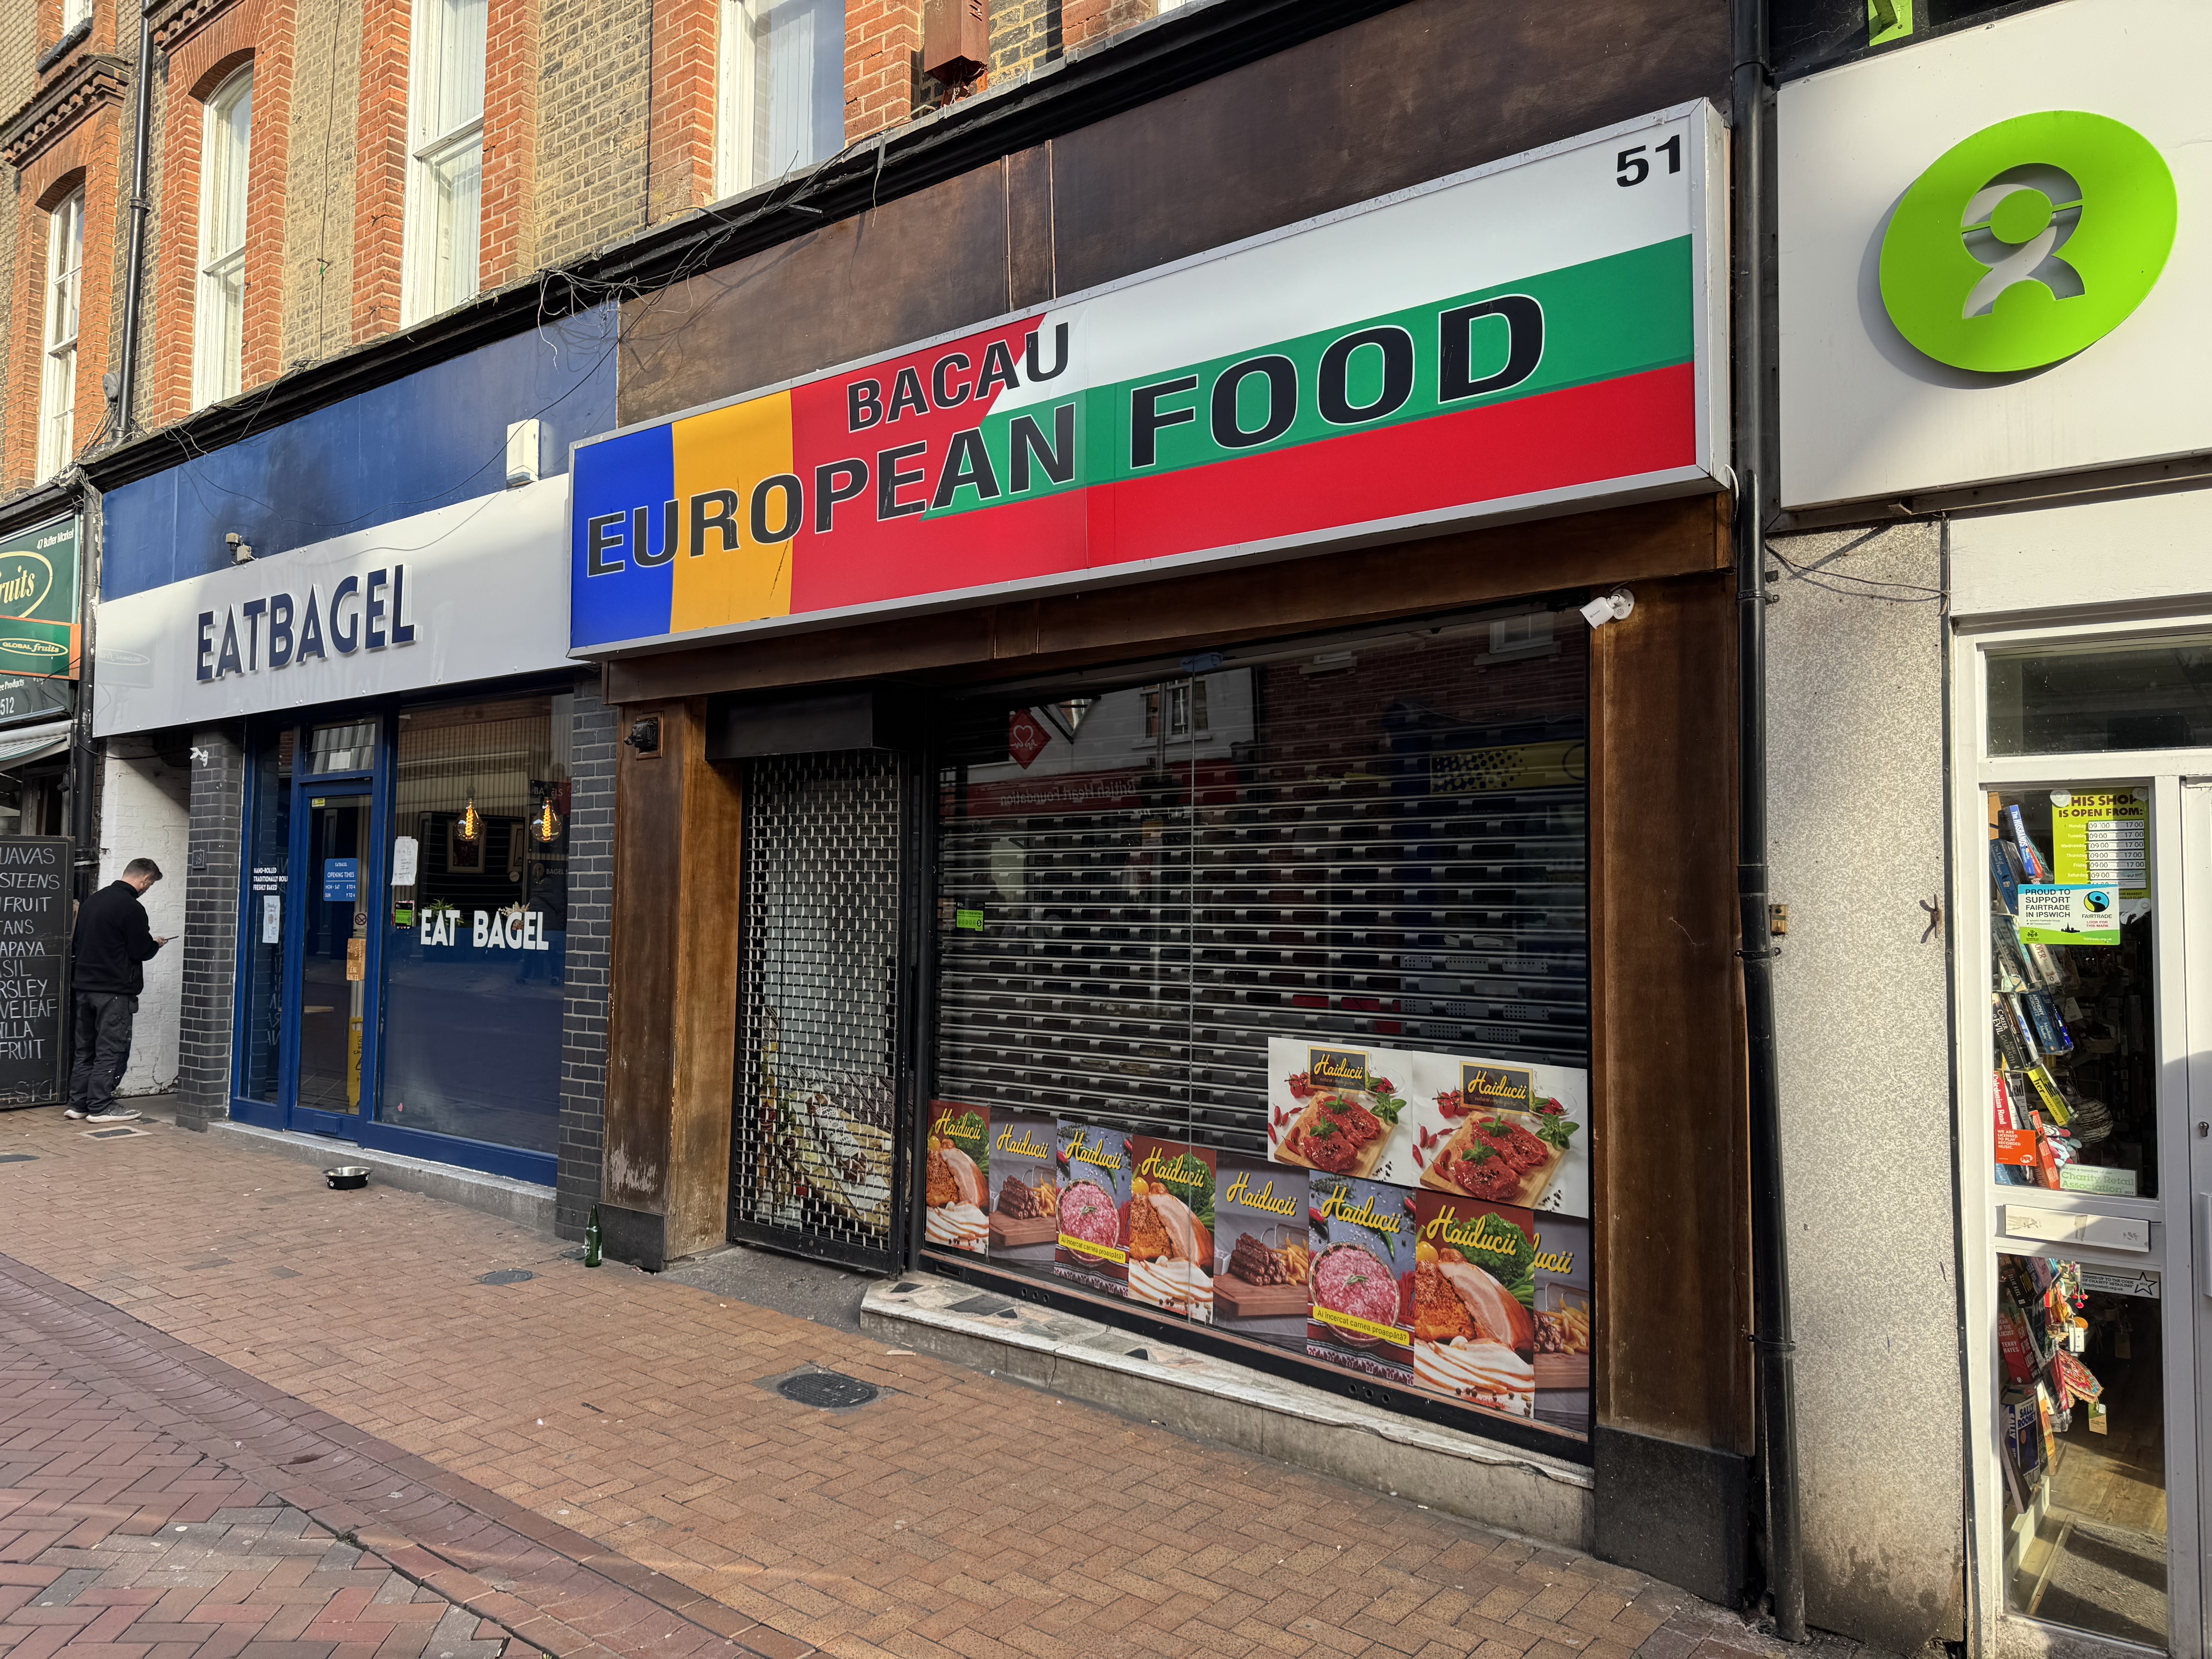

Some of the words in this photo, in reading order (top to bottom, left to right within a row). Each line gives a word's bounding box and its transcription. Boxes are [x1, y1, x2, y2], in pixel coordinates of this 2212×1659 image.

[1616, 135, 1681, 187] 51
[848, 322, 1069, 433] BACAU
[587, 402, 1077, 577] EUROPEAN
[1130, 293, 1545, 469] FOOD
[37, 539, 43, 549] 47
[44, 536, 57, 548] Butter
[58, 528, 74, 543] Market
[0, 565, 35, 603] ruits
[197, 564, 416, 681] EATBAGEL
[31, 643, 59, 653] fruits
[5, 679, 24, 689] Products
[2059, 809, 2069, 817] IS
[2071, 809, 2102, 817] OPEN
[2106, 807, 2143, 816] FROM:
[2066, 796, 2095, 807] HIS
[2013, 819, 2028, 848] HUSBANDS
[4, 896, 52, 912] FRUIT
[421, 909, 460, 946] EAT
[473, 909, 549, 950] BAGEL
[2028, 995, 2040, 1017] HOROWITZ
[2032, 994, 2045, 1016] ANTHONY
[1993, 1019, 2004, 1035] EVIL
[1997, 1009, 2008, 1030] CAREER
[2001, 1035, 2016, 1064] GALBRAITH
[1314, 1053, 1363, 1080] Haiducii
[1468, 1070, 1526, 1099] Haiducii
[1993, 1074, 2002, 1109] Caledonian
[935, 1108, 981, 1140] Haiducii
[1997, 1109, 2006, 1125] Road
[996, 1123, 1048, 1159] Haiducii
[1065, 1132, 1122, 1170] Haiducii
[1141, 1146, 1205, 1188] Haiducii
[2061, 1171, 2100, 1184] Charity
[2104, 1176, 2134, 1186] Retail
[1226, 1171, 1297, 1217] Haiducii
[2062, 1180, 2123, 1194] Association
[1321, 1185, 1401, 1234] Haiducii
[1426, 1205, 1516, 1256] Haiducii
[1083, 1244, 1098, 1253] carnea
[2008, 1274, 2017, 1286] ELLIE
[2082, 1283, 2123, 1291] charityretail.org.uk
[1325, 1311, 1348, 1325] încercat
[1350, 1320, 1370, 1331] carnea
[1372, 1326, 1407, 1341] proaspătă?
[2018, 1412, 2036, 1427] ROONEY
[2020, 1403, 2033, 1418] SALLY
